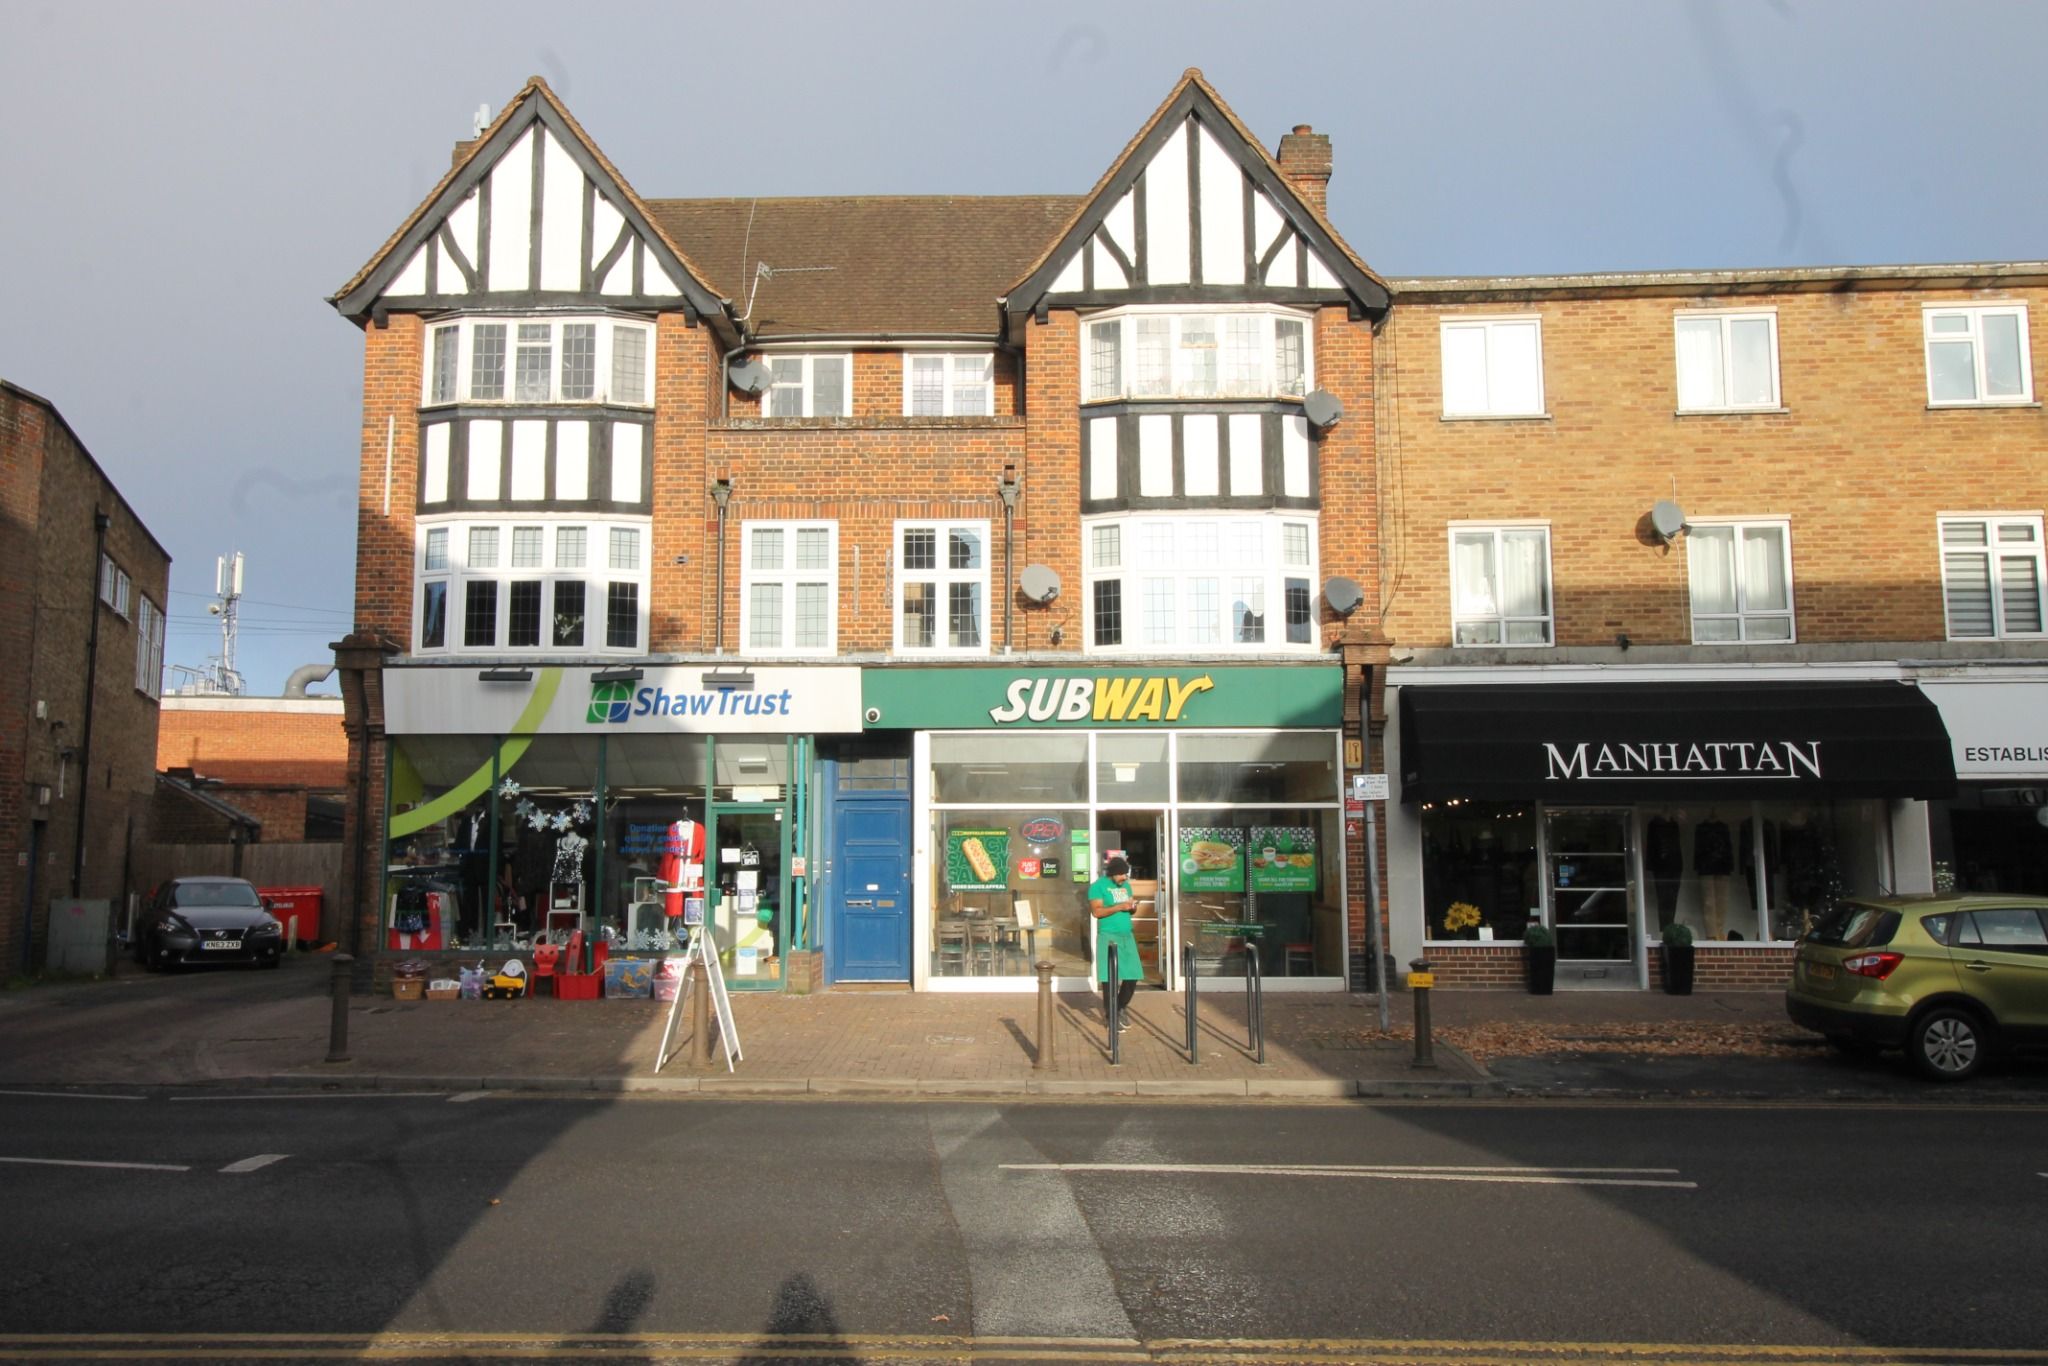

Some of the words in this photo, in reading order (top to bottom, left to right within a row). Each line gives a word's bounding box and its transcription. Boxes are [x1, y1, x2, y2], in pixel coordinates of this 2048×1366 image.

[634, 687, 714, 716] Shaw
[718, 687, 792, 716] Trust
[989, 673, 1214, 724] SUBWAY
[1541, 741, 1821, 779] MANHATTAN
[630, 824, 666, 833] Donation
[1023, 823, 1064, 837] OPEN
